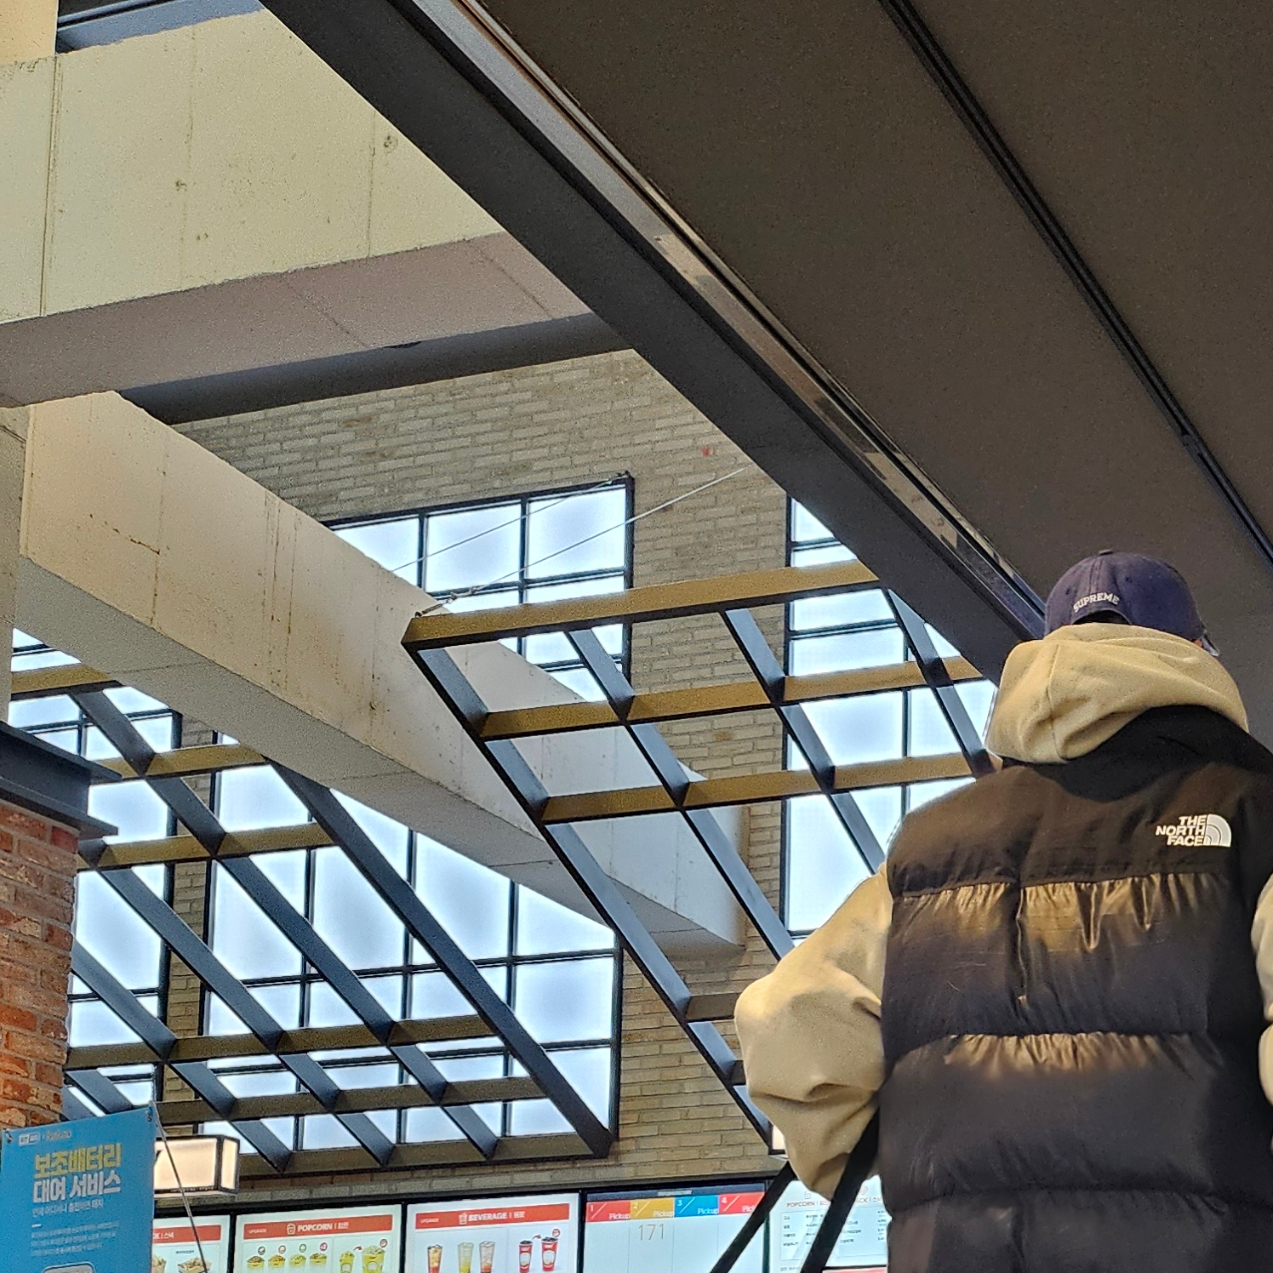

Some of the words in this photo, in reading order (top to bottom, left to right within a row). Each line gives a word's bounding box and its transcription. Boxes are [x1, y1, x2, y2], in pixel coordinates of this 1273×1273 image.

[1073, 592, 1120, 613] SUPREME
[1179, 814, 1207, 826] THE
[1155, 824, 1206, 836] NORTH
[1166, 835, 1204, 847] FACE
[34, 1142, 122, 1179] 보조배터리
[33, 1176, 67, 1203] 대여
[69, 1169, 121, 1198] 서비스
[677, 1199, 683, 1207] 3
[468, 1212, 507, 1222] BEVERAGE
[608, 1212, 631, 1220] Pickup
[653, 1210, 674, 1218] Pickup
[698, 1207, 719, 1216] Pickup
[297, 1223, 334, 1232] POPCORN
[638, 1222, 666, 1241] 171
